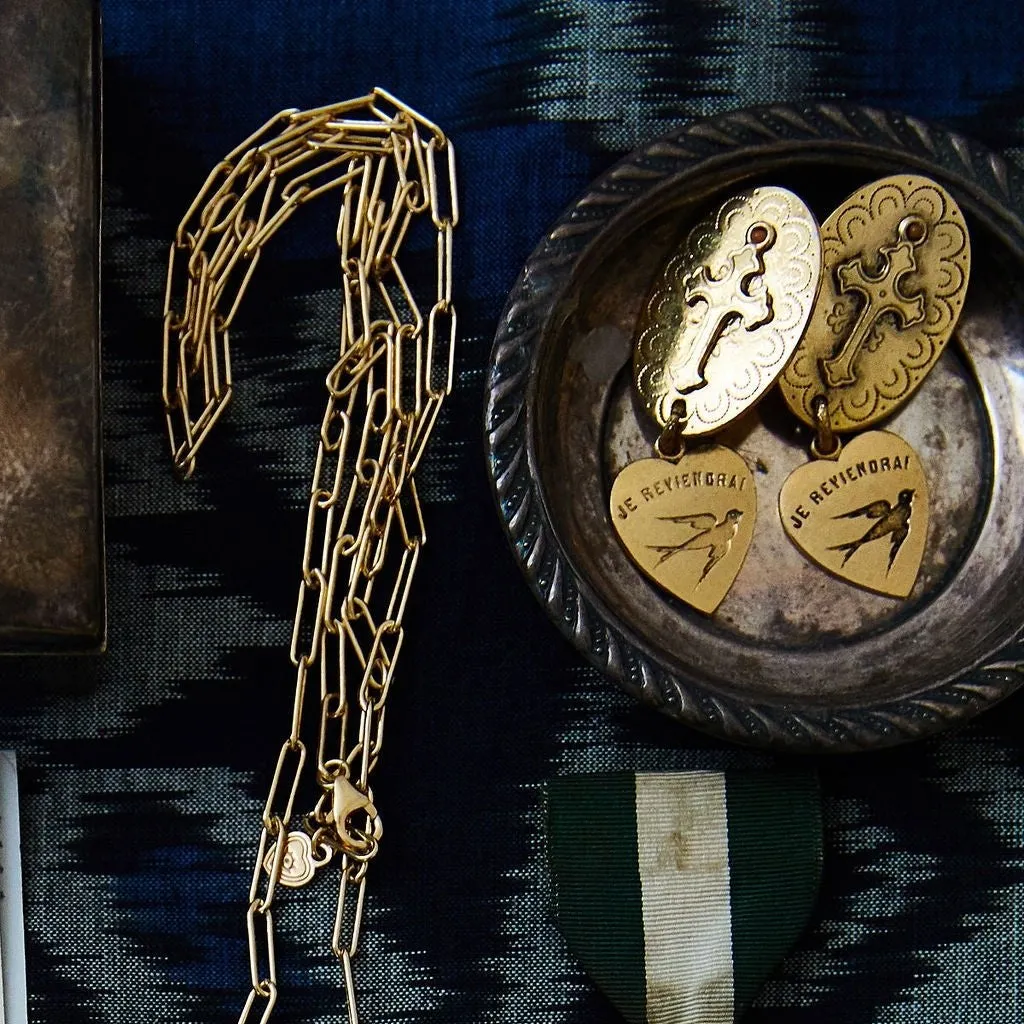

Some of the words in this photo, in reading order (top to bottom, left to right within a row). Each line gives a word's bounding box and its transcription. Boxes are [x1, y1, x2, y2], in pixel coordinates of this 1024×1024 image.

[616, 497, 638, 520] JE
[640, 471, 747, 502] REVIENDRAI
[790, 505, 810, 529] JE
[809, 455, 911, 505] REVIENDRAI
